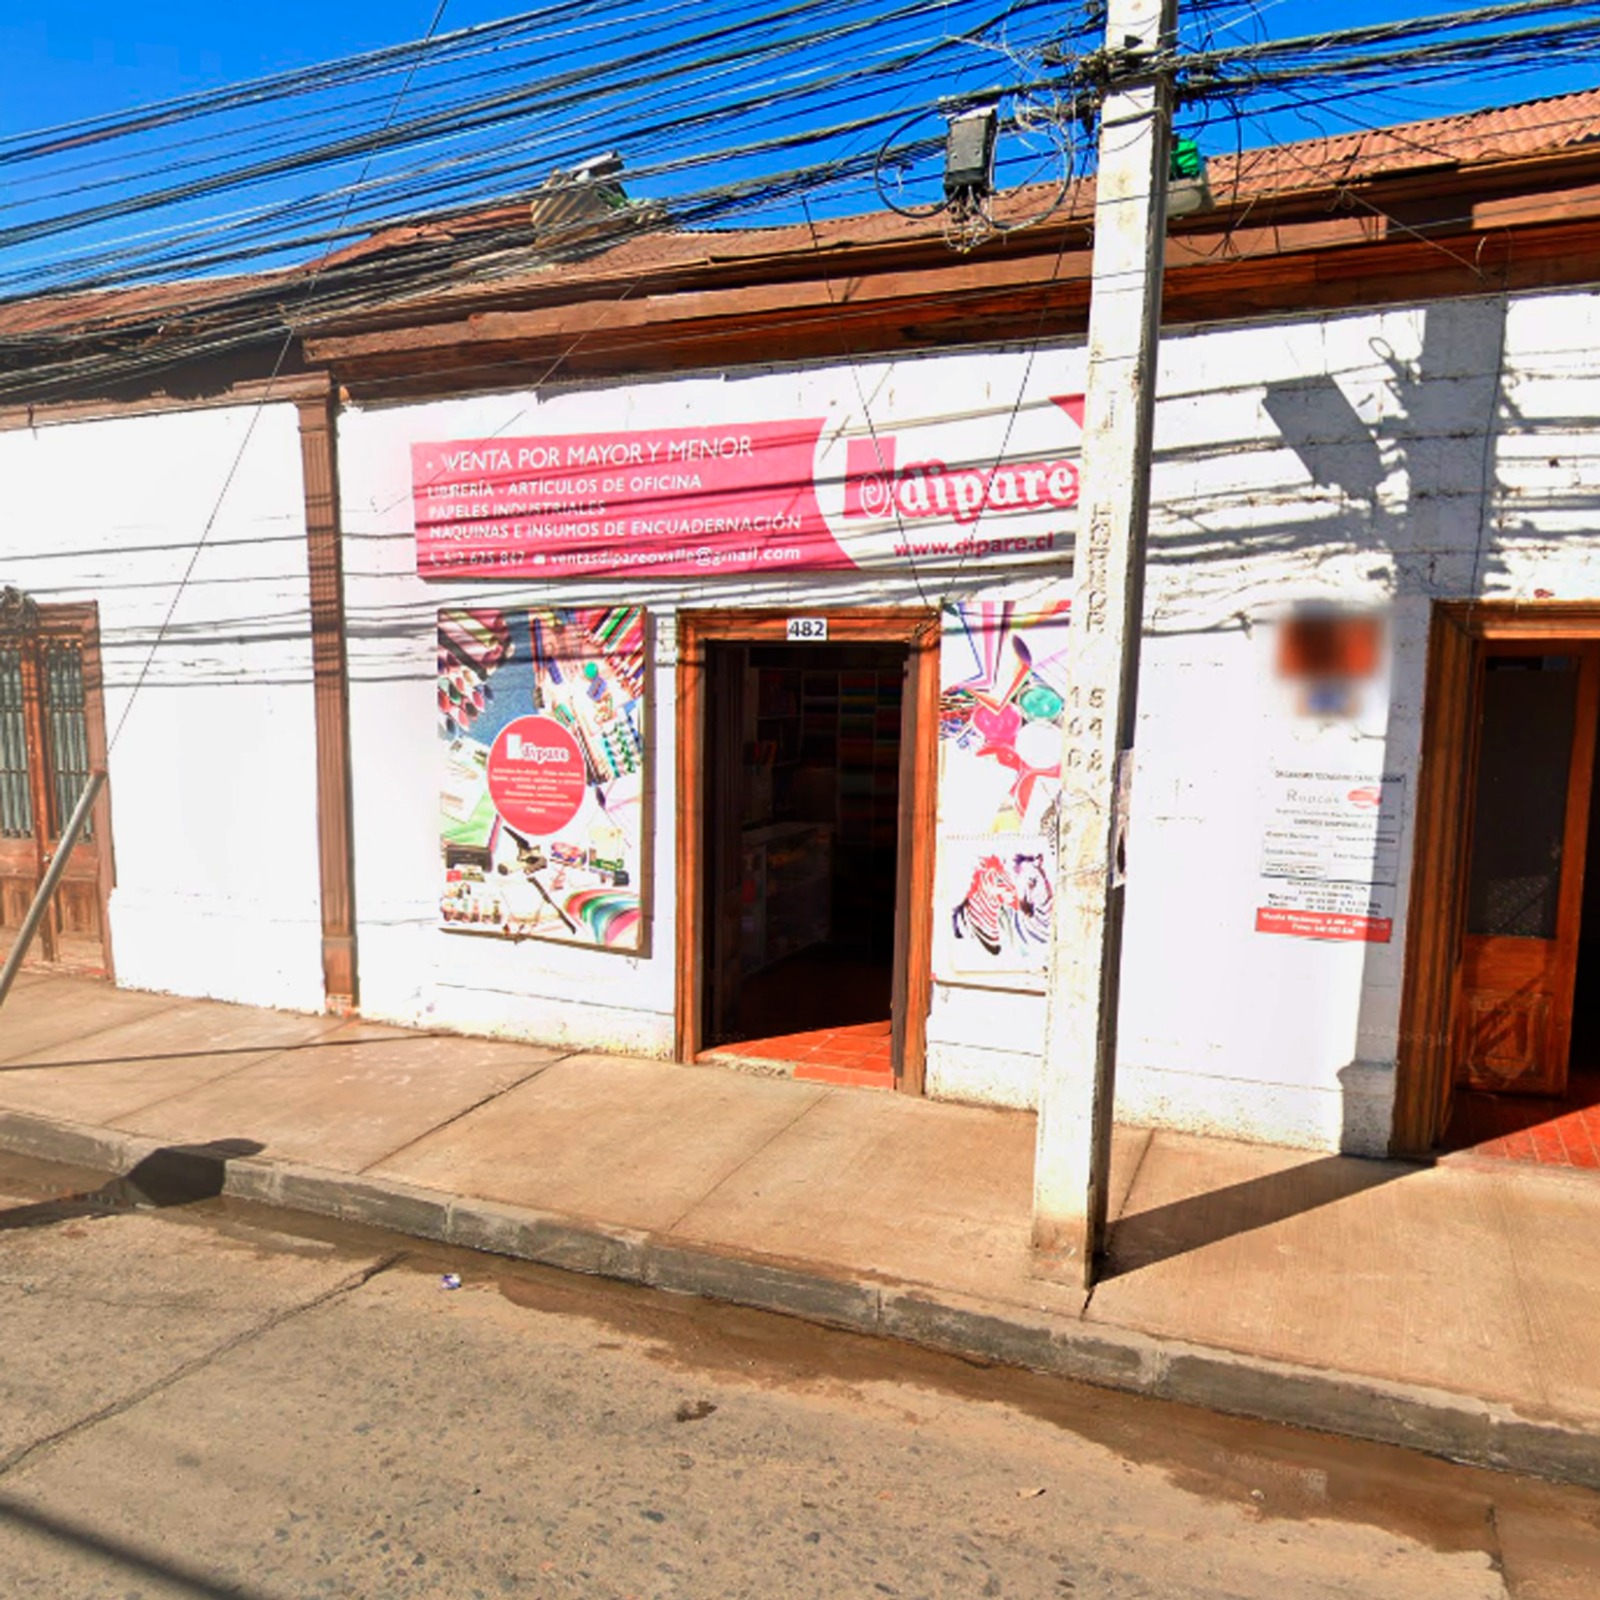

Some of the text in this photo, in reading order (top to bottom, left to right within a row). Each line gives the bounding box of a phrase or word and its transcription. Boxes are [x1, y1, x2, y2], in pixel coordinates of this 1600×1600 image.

[441, 435, 753, 471] VENTA POR MAYOR Y MENOR
[427, 474, 702, 500] LIBRERÍA ARTÍCULOS DE OFICINA
[896, 460, 1078, 523] dipare
[428, 499, 607, 520] PAPELES INDUSTRIALES
[513, 524, 521, 539] E
[527, 521, 599, 539] INSUMOS
[604, 520, 624, 536] DE
[631, 513, 802, 535] ENCUADERNACIÓN
[894, 532, 1055, 559] www.dipare.cl
[788, 620, 825, 638] 482
